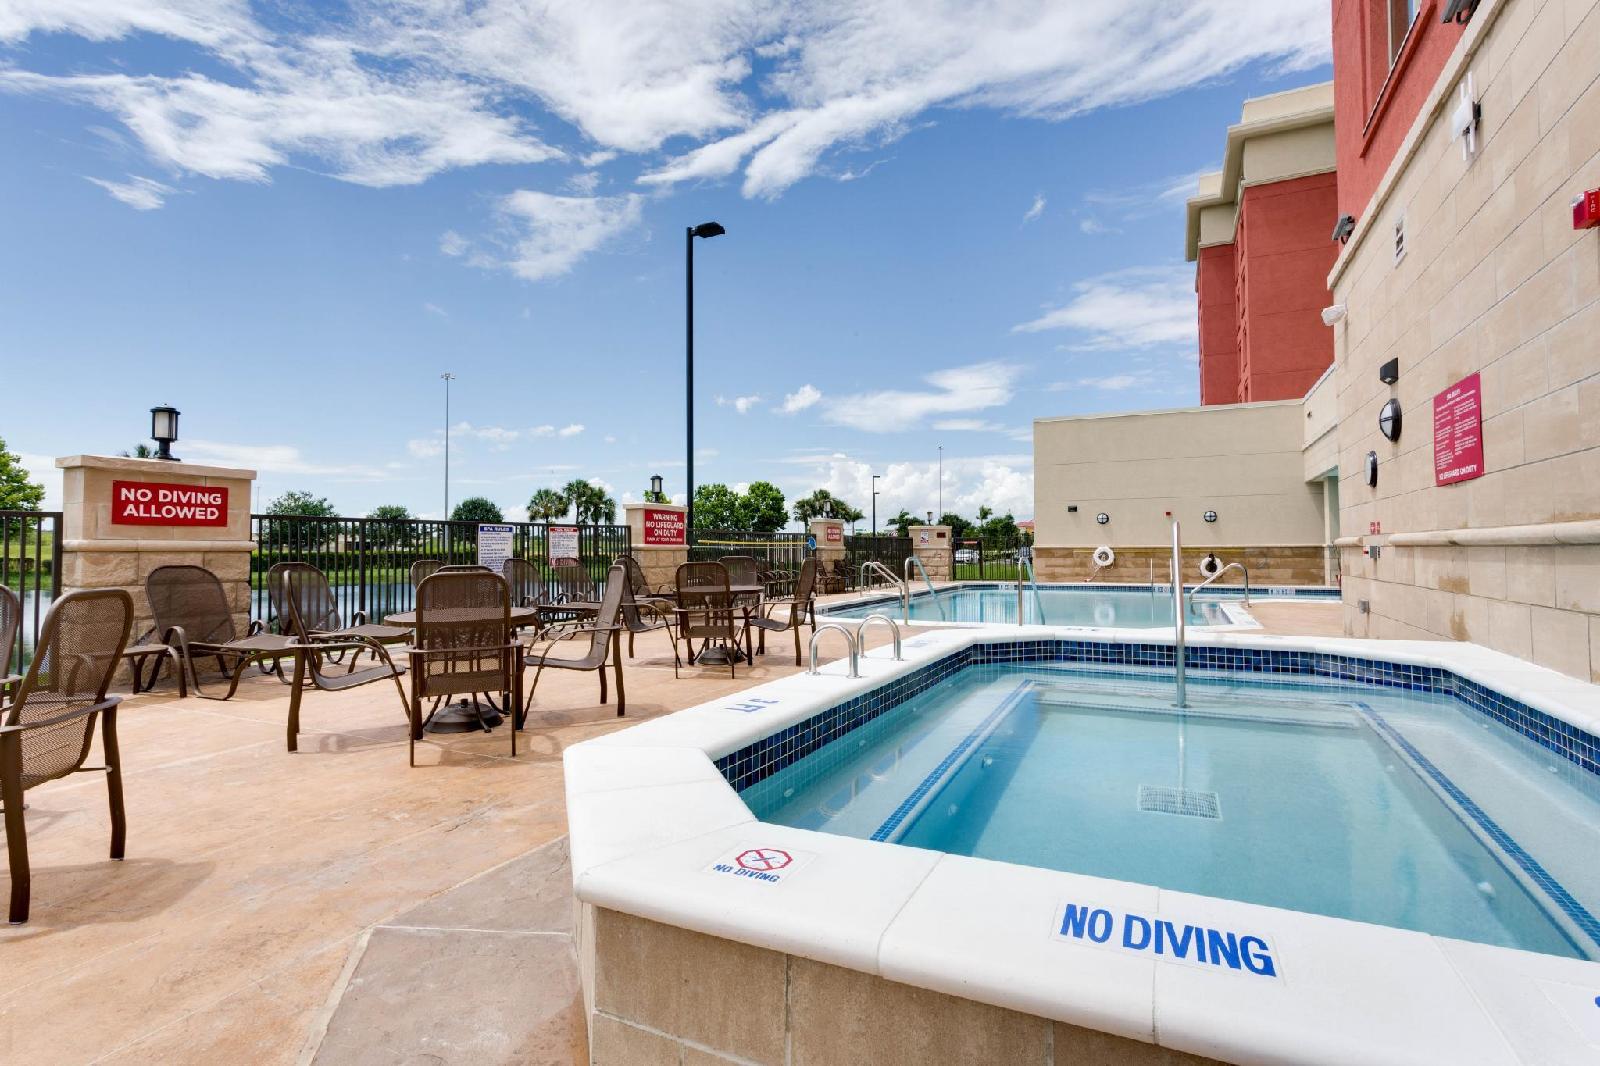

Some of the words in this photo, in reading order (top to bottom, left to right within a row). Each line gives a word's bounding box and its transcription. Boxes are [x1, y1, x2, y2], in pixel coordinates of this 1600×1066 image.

[120, 487, 153, 502] NO
[158, 489, 222, 505] DIVING
[122, 504, 220, 520] ALLOWED
[652, 513, 678, 522] WARNING
[653, 528, 663, 536] ON
[663, 529, 678, 537] DUTY
[713, 864, 734, 873] NO
[734, 868, 781, 883] DIVING
[1060, 903, 1114, 943] NO
[1122, 913, 1277, 977] DIVING
